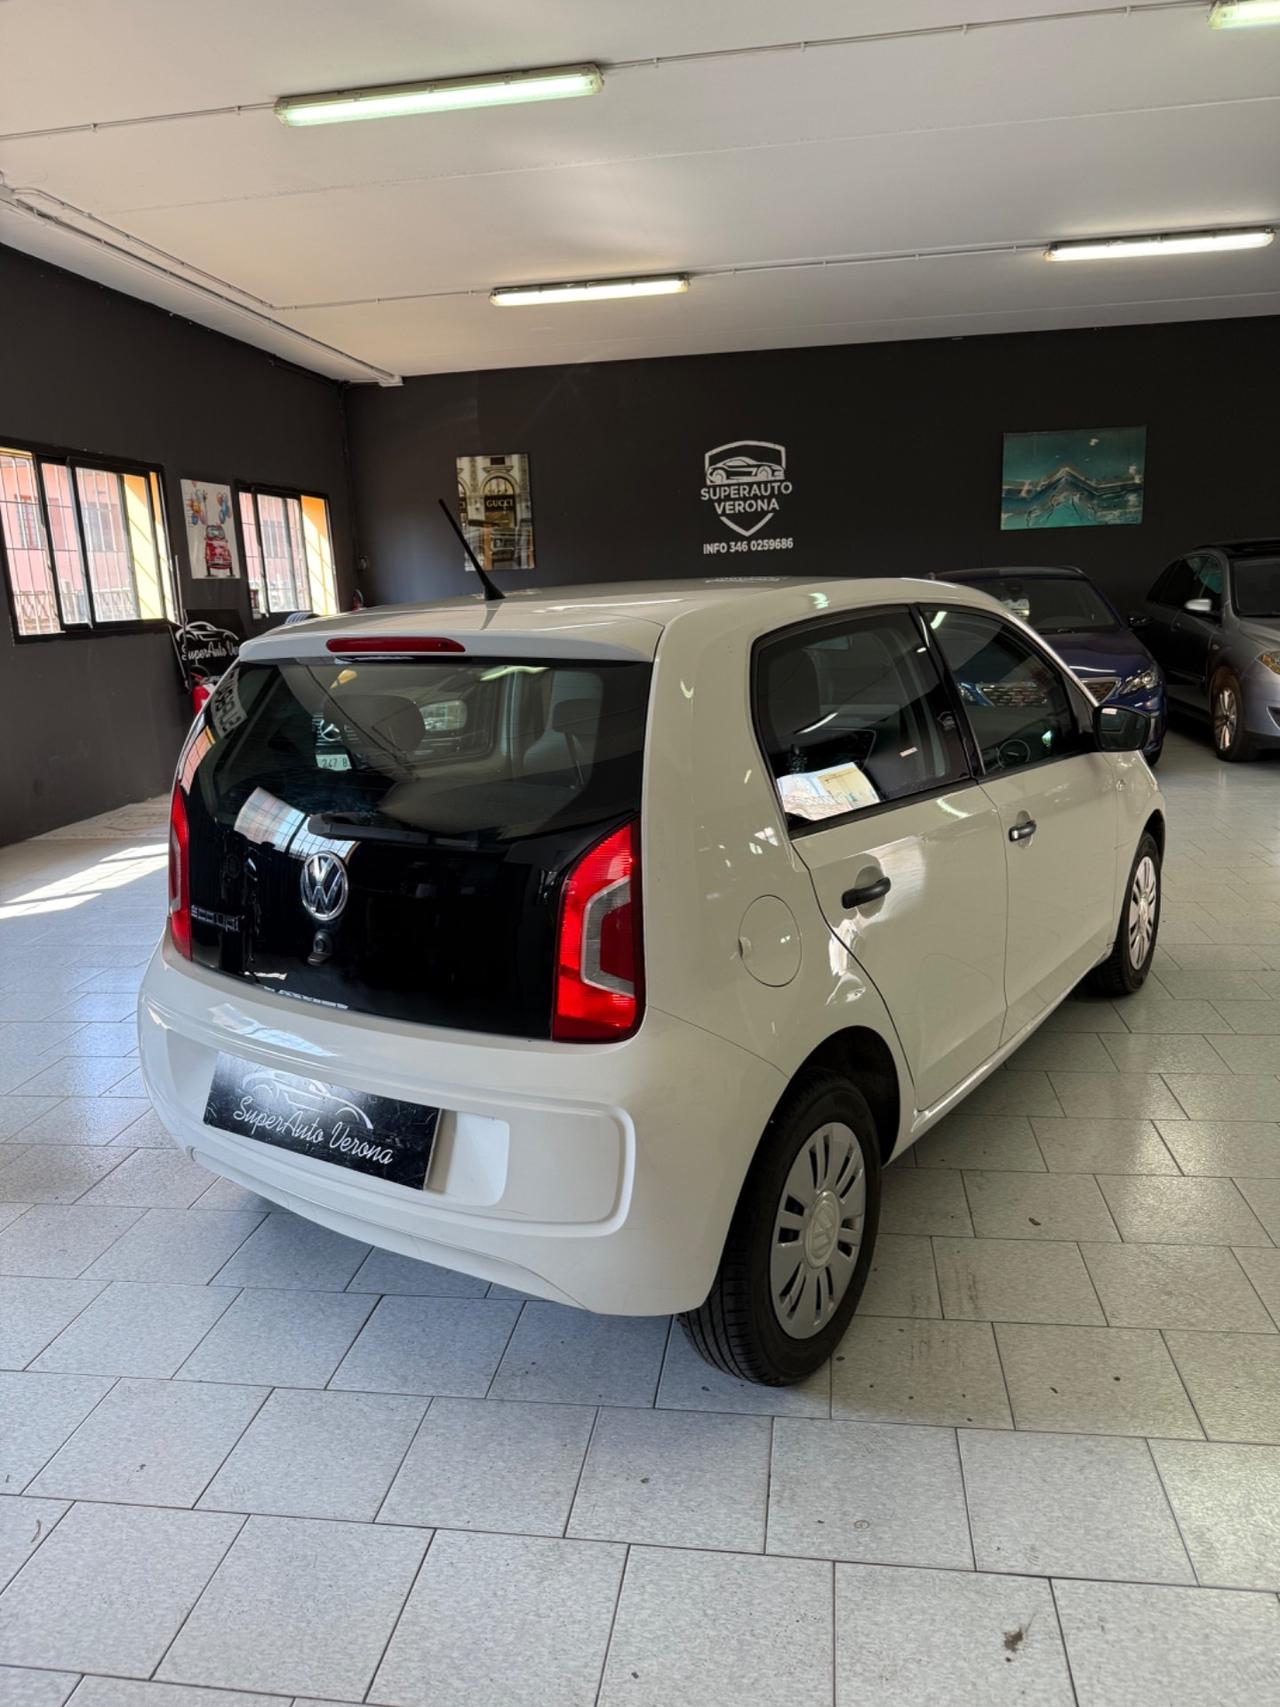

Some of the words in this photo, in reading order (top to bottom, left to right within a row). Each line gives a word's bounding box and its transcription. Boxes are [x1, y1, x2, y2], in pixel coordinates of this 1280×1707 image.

[700, 481, 793, 501] SUPERAUTO
[486, 499, 513, 508] GUCCI
[714, 498, 780, 515] VERONA
[703, 542, 728, 555] INFO
[729, 541, 749, 553] 346
[750, 537, 794, 552] 0259686
[233, 1096, 324, 1143] SuperAuto
[329, 1121, 394, 1165] Verona
